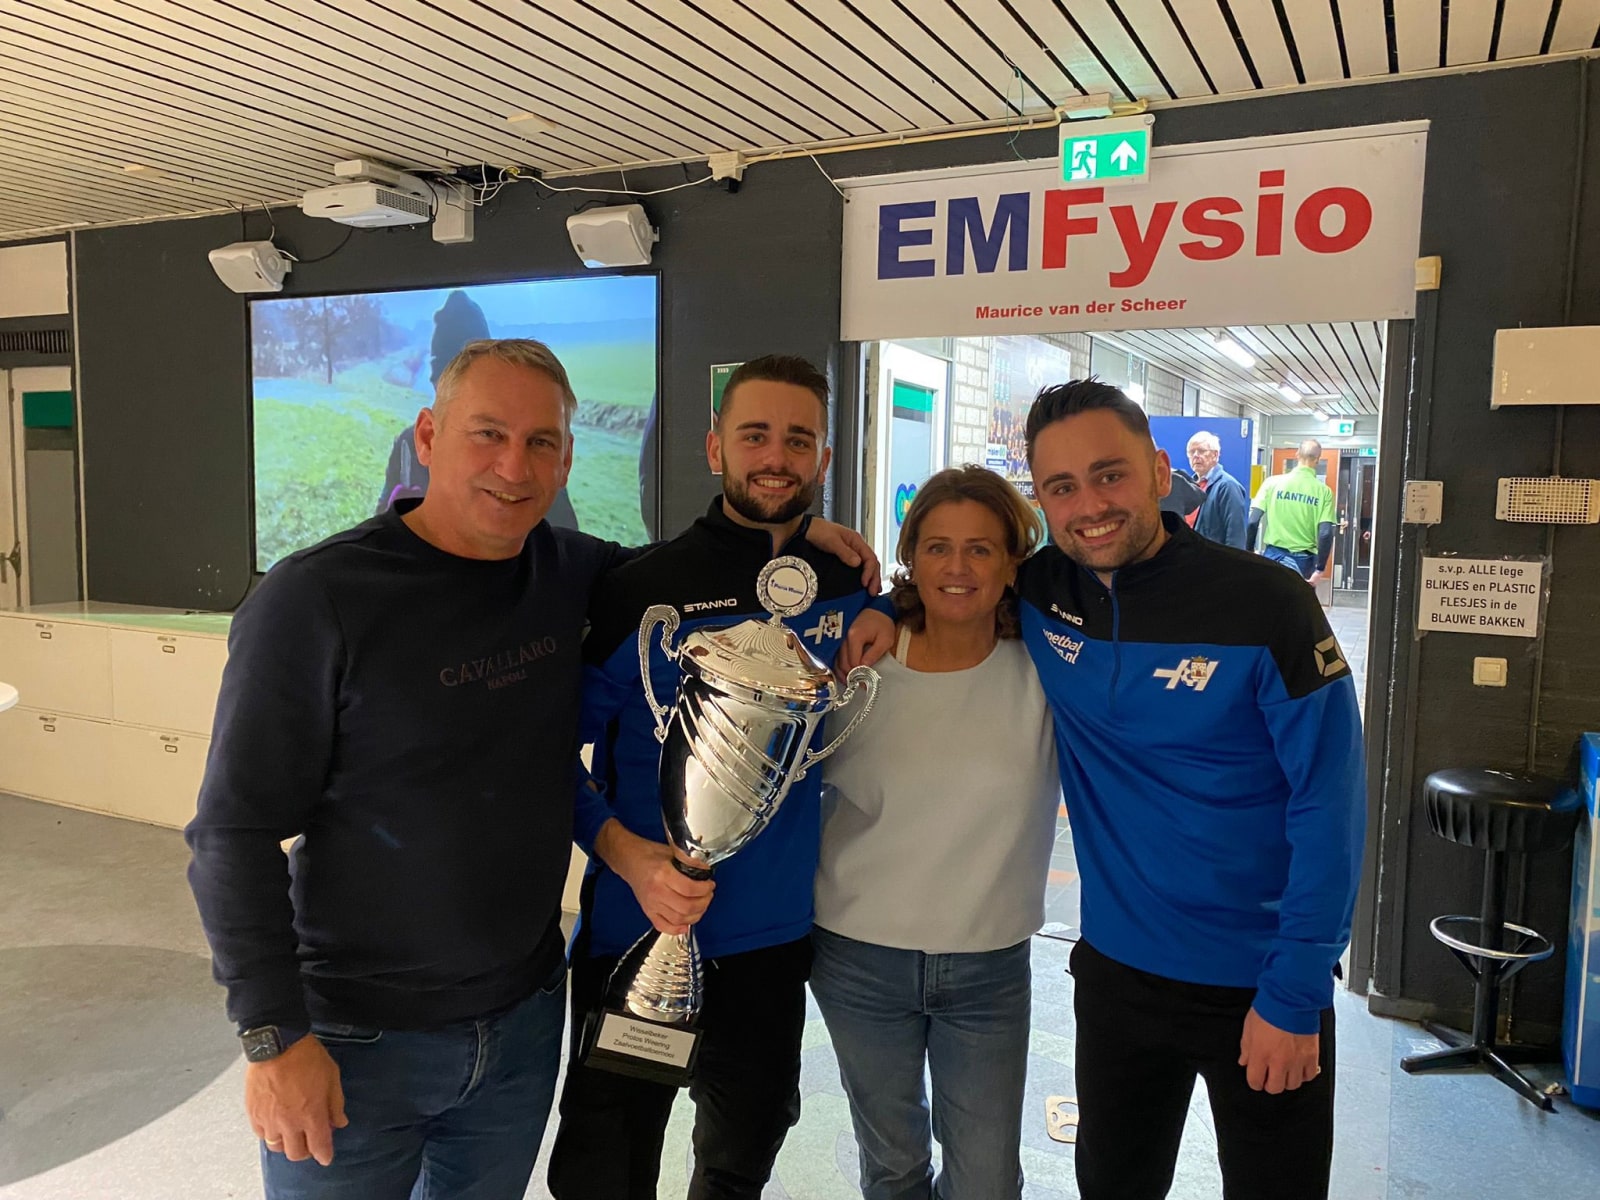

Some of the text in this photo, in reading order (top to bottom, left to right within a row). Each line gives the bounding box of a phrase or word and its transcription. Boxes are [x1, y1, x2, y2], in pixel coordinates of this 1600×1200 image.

[876, 169, 1373, 288] EMFysio
[975, 297, 1187, 319] Maurice van der Scheer
[1276, 490, 1319, 506] KANTINE
[1438, 565, 1524, 578] s.v.p. ALLE lege
[1425, 579, 1536, 594] BLIKJES en PLASTIC
[684, 598, 738, 612] STANNO
[1440, 597, 1518, 610] FLESJES in de
[1431, 613, 1525, 628] BLAUWE BAKKEN
[440, 636, 556, 687] CAVALLARO
